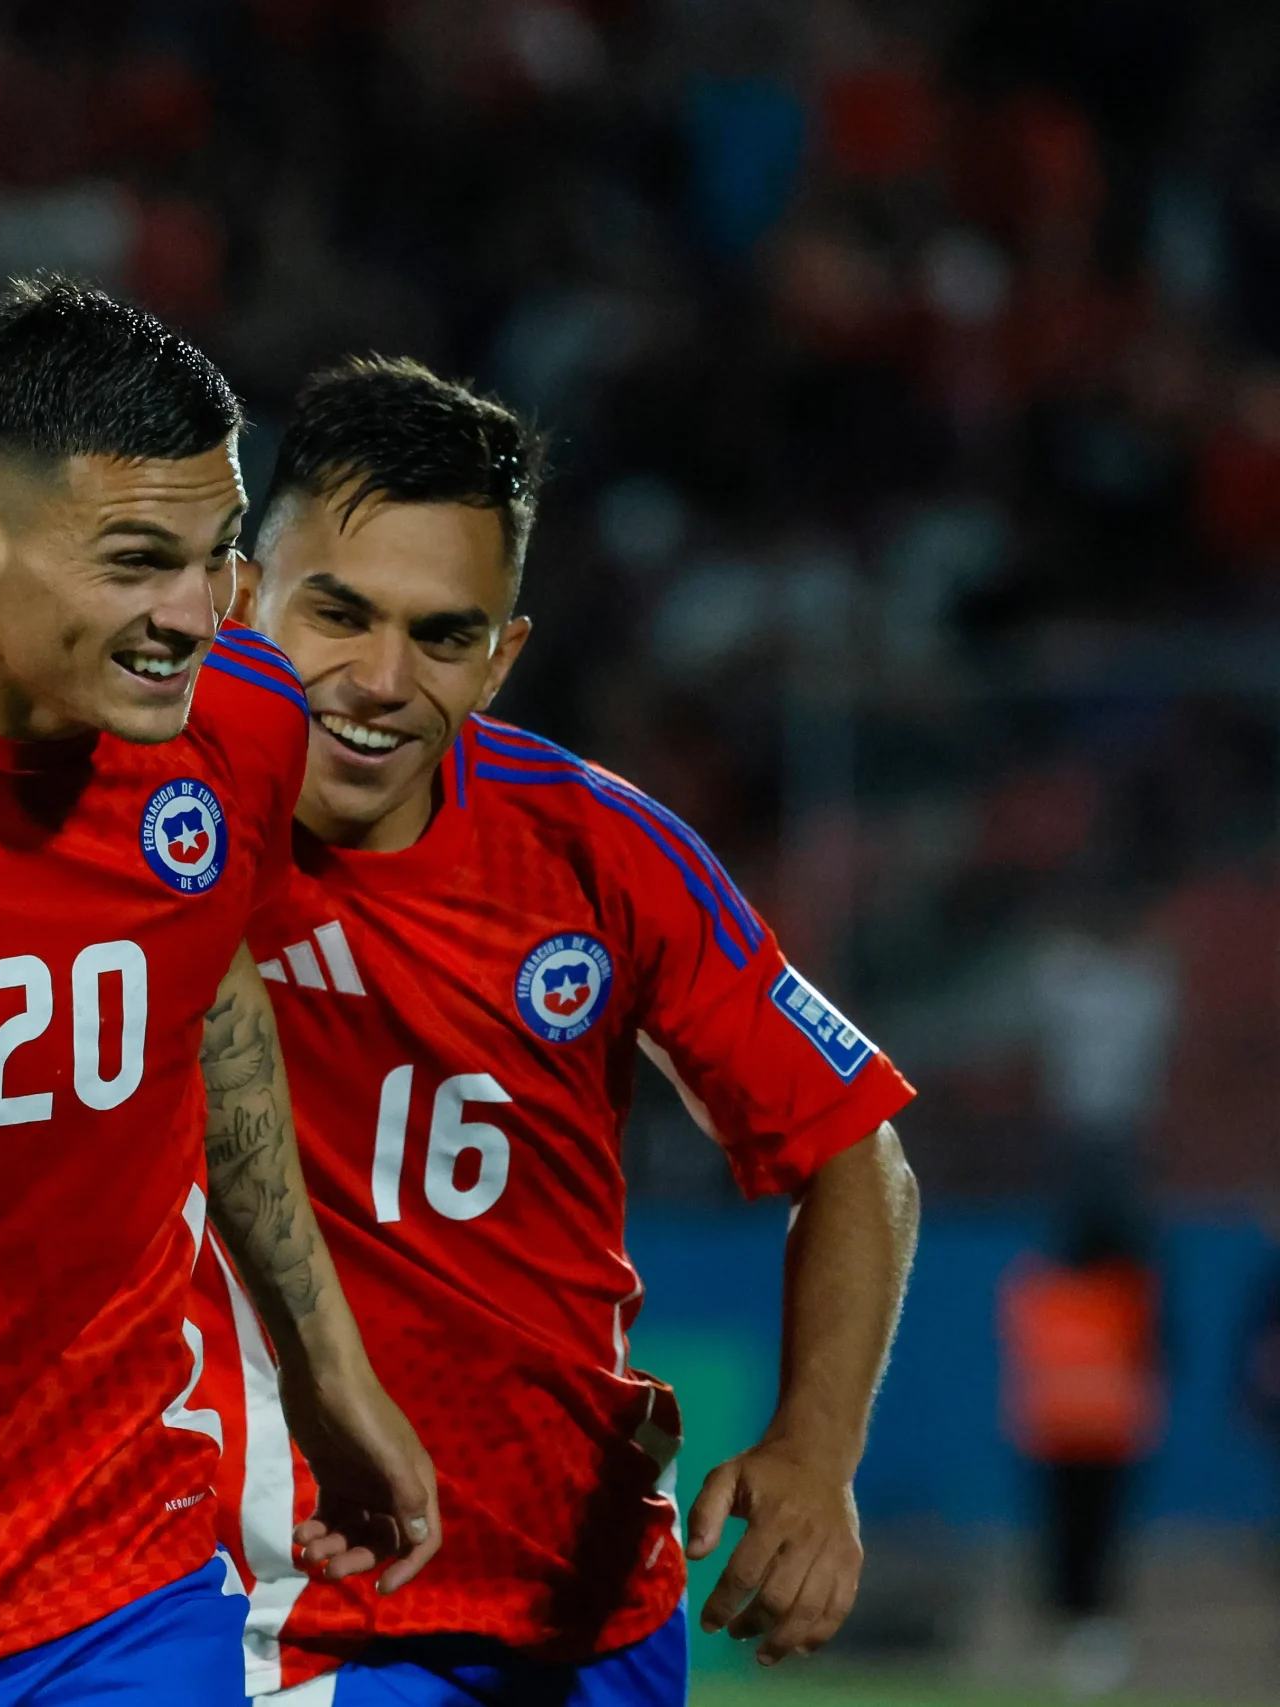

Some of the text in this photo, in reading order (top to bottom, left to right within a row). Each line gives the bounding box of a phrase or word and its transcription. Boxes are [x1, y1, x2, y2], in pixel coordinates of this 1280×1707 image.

[143, 782, 222, 852] FEDERACION DE FUTBOL
[180, 863, 219, 890] DE CHILE
[372, 1065, 513, 1224] 16
